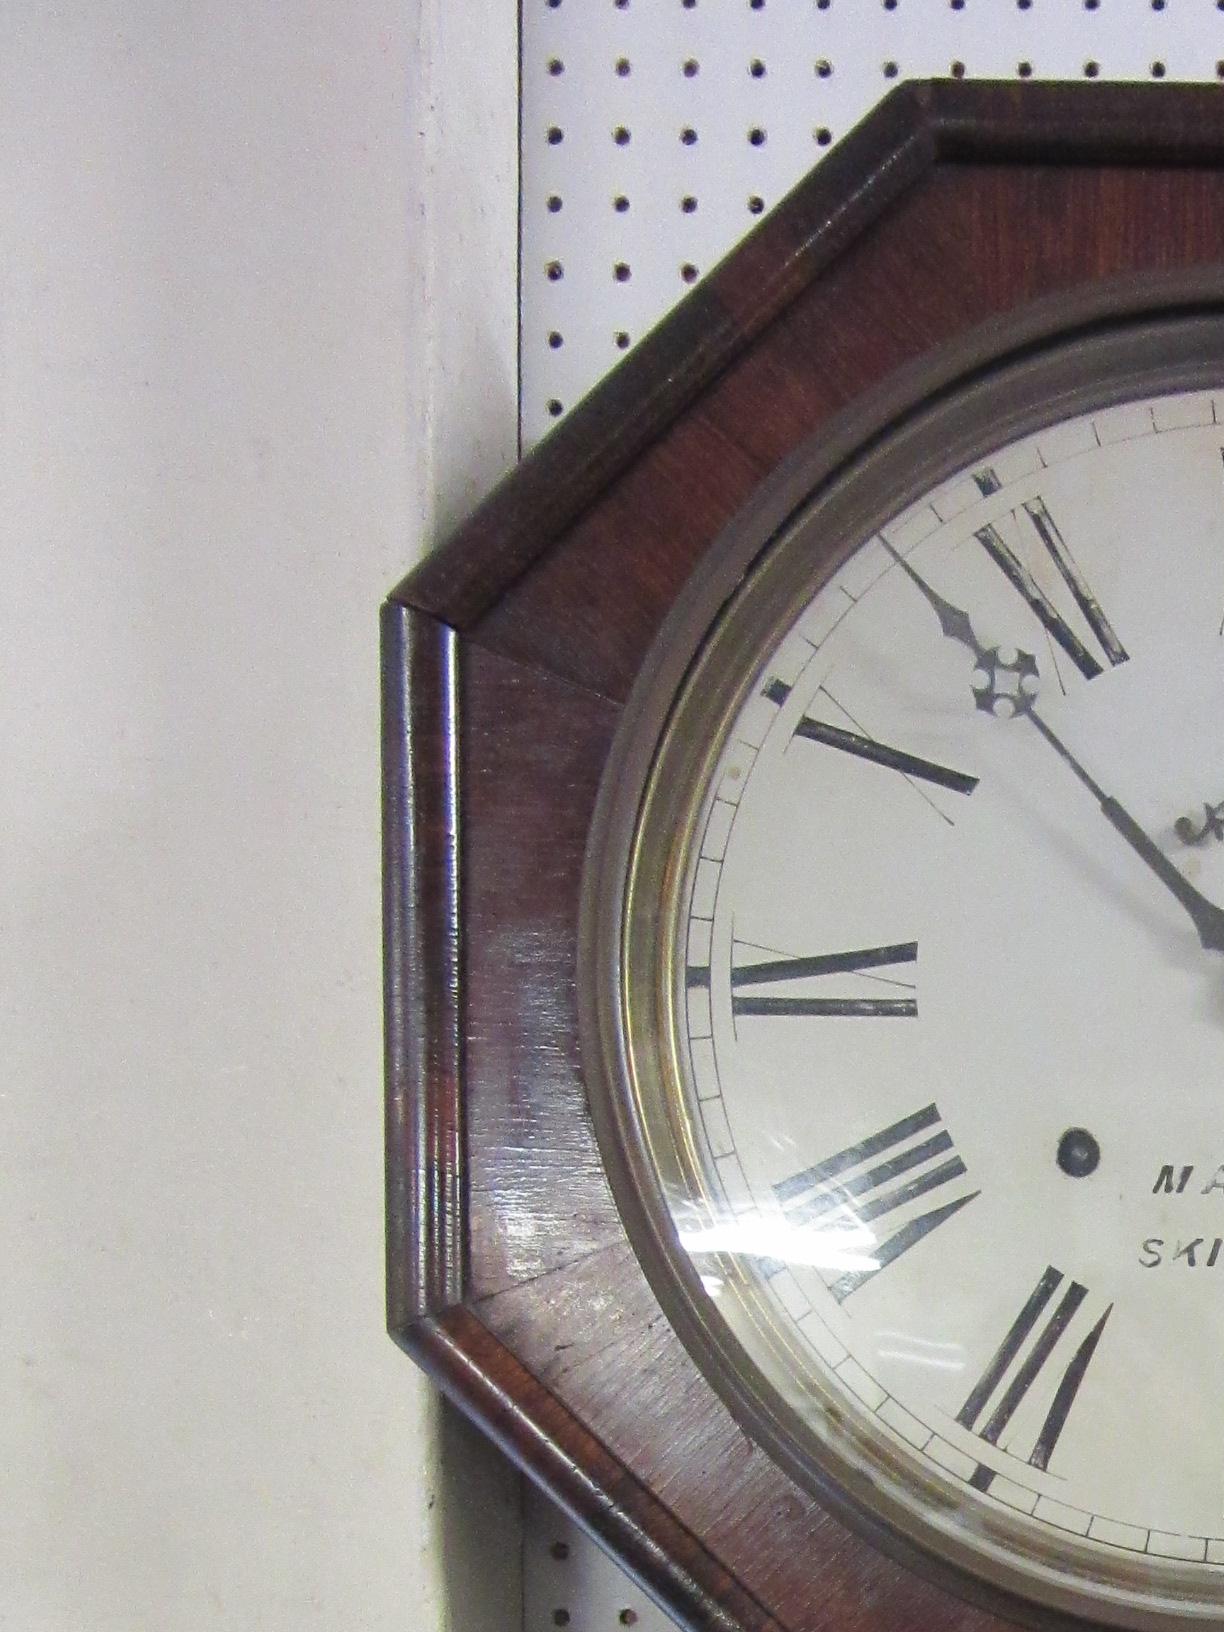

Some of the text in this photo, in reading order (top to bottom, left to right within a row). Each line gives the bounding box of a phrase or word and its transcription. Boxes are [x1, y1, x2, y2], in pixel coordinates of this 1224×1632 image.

[973, 496, 1131, 696] XI
[792, 686, 980, 826] X
[731, 938, 918, 1018] IX
[954, 1265, 1114, 1472] VII
